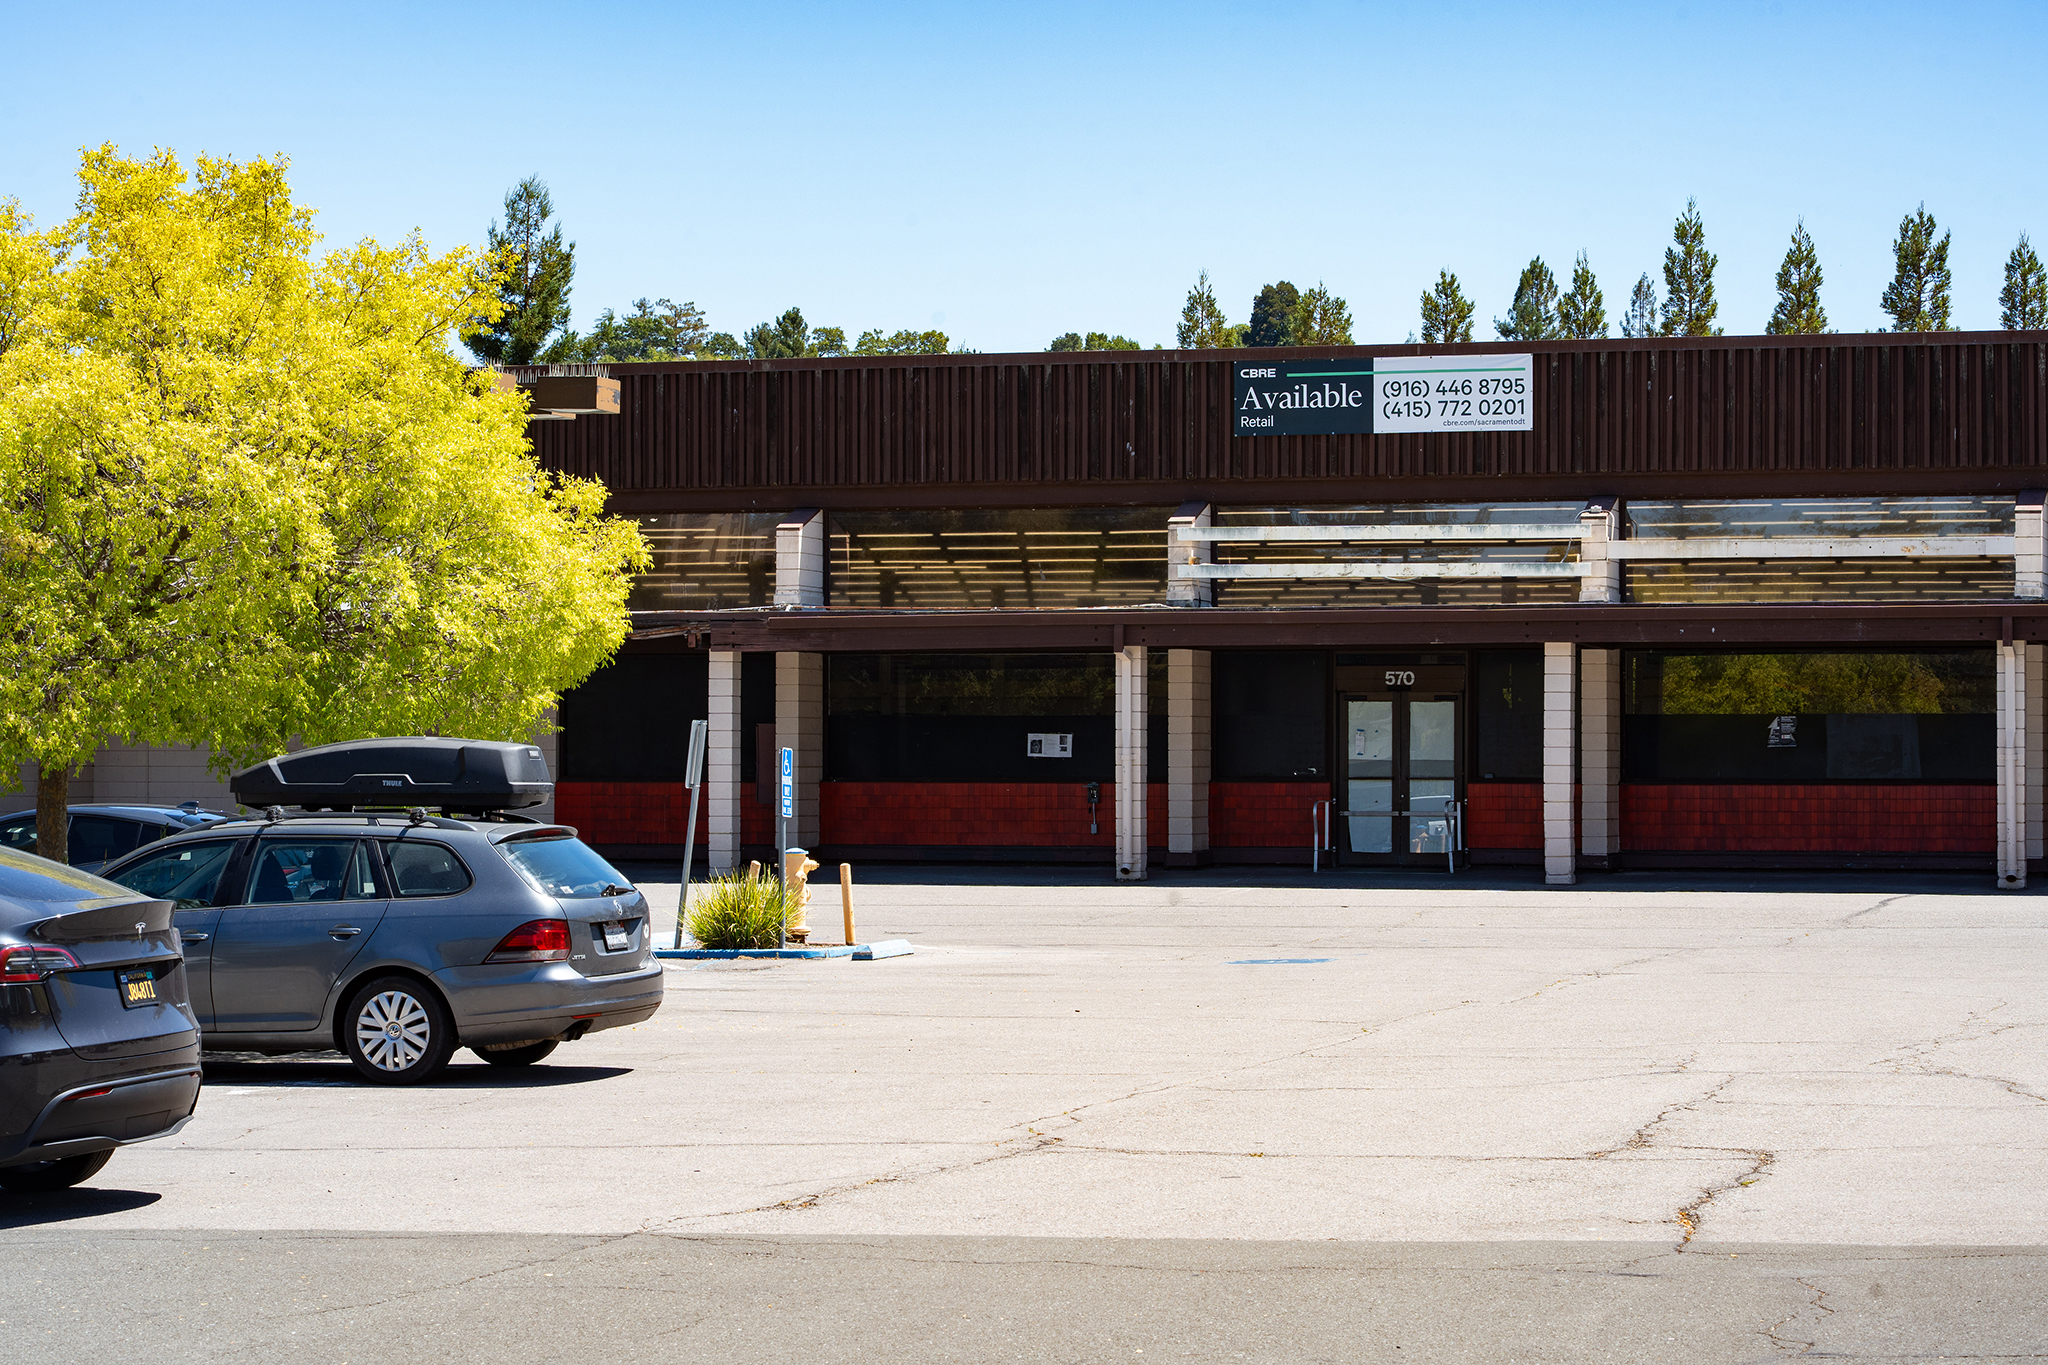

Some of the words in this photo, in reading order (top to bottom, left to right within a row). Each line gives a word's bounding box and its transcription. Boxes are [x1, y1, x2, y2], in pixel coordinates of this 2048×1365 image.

[1240, 368, 1276, 378] CBRE
[1240, 383, 1363, 410] Available
[1382, 380, 1430, 399] (916)
[1436, 379, 1473, 396] 446
[1478, 378, 1525, 395] 8795
[1382, 400, 1432, 419] (415)
[1438, 399, 1472, 417] 772
[1478, 398, 1525, 416] 0201
[1240, 415, 1274, 428] Retail
[1442, 418, 1526, 427] cbre.com/sacramentodt
[1385, 671, 1415, 686] 570
[128, 980, 156, 1001] J848T1
